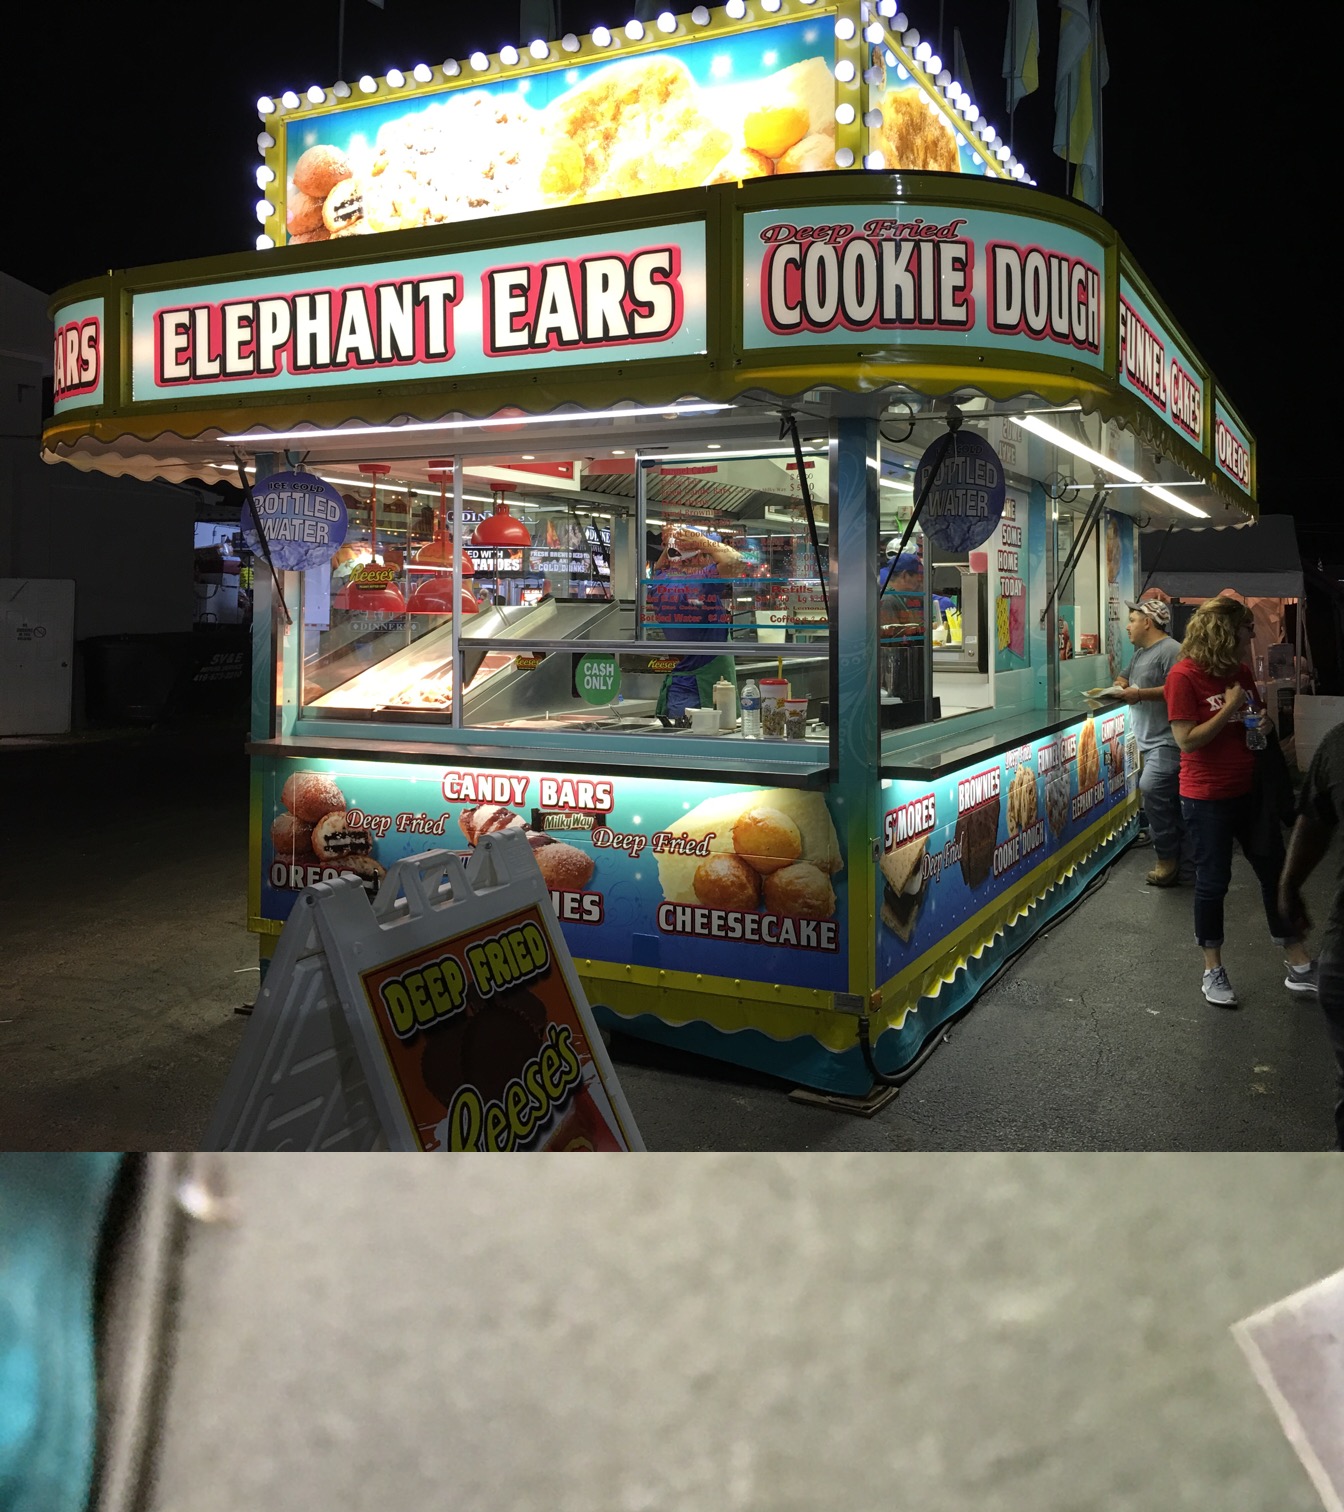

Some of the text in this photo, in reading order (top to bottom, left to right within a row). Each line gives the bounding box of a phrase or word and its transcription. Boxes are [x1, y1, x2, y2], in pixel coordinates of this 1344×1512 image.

[760, 218, 967, 245] Deep Fried
[767, 237, 1100, 350] COOKIE DOUGH
[159, 248, 677, 382] ELEPHANT EARS
[54, 322, 98, 395] ARS
[1119, 300, 1201, 439] FUNNEL CAKES
[1218, 421, 1249, 487] OREOS
[268, 482, 325, 493] ICE COLD
[928, 489, 989, 518] WATER
[252, 491, 341, 544] BOTTLED WATER
[1002, 525, 1022, 547] SOME
[349, 563, 395, 583] Reese's
[538, 563, 559, 572] COLD
[998, 550, 1018, 572] HOME
[771, 585, 813, 593] Refills
[1000, 578, 1023, 597] TODAY
[769, 614, 801, 623] Coffee
[584, 676, 614, 690] ONLY
[1038, 743, 1059, 776] FUNNEL
[1060, 734, 1077, 764] CAKES
[444, 773, 612, 810] CANDY BARS
[958, 767, 1000, 815] BROWNIES
[347, 809, 449, 837] Deep Fried
[885, 796, 936, 848] S'MORES
[592, 828, 715, 858] Deep Fried
[923, 831, 964, 883] Deep Fried
[993, 820, 1044, 878] COOKIE DOUGH
[659, 903, 837, 950] CHEESECAKE
[381, 922, 549, 1037] DEEP FRIED
[447, 1023, 580, 1152] Reese's
